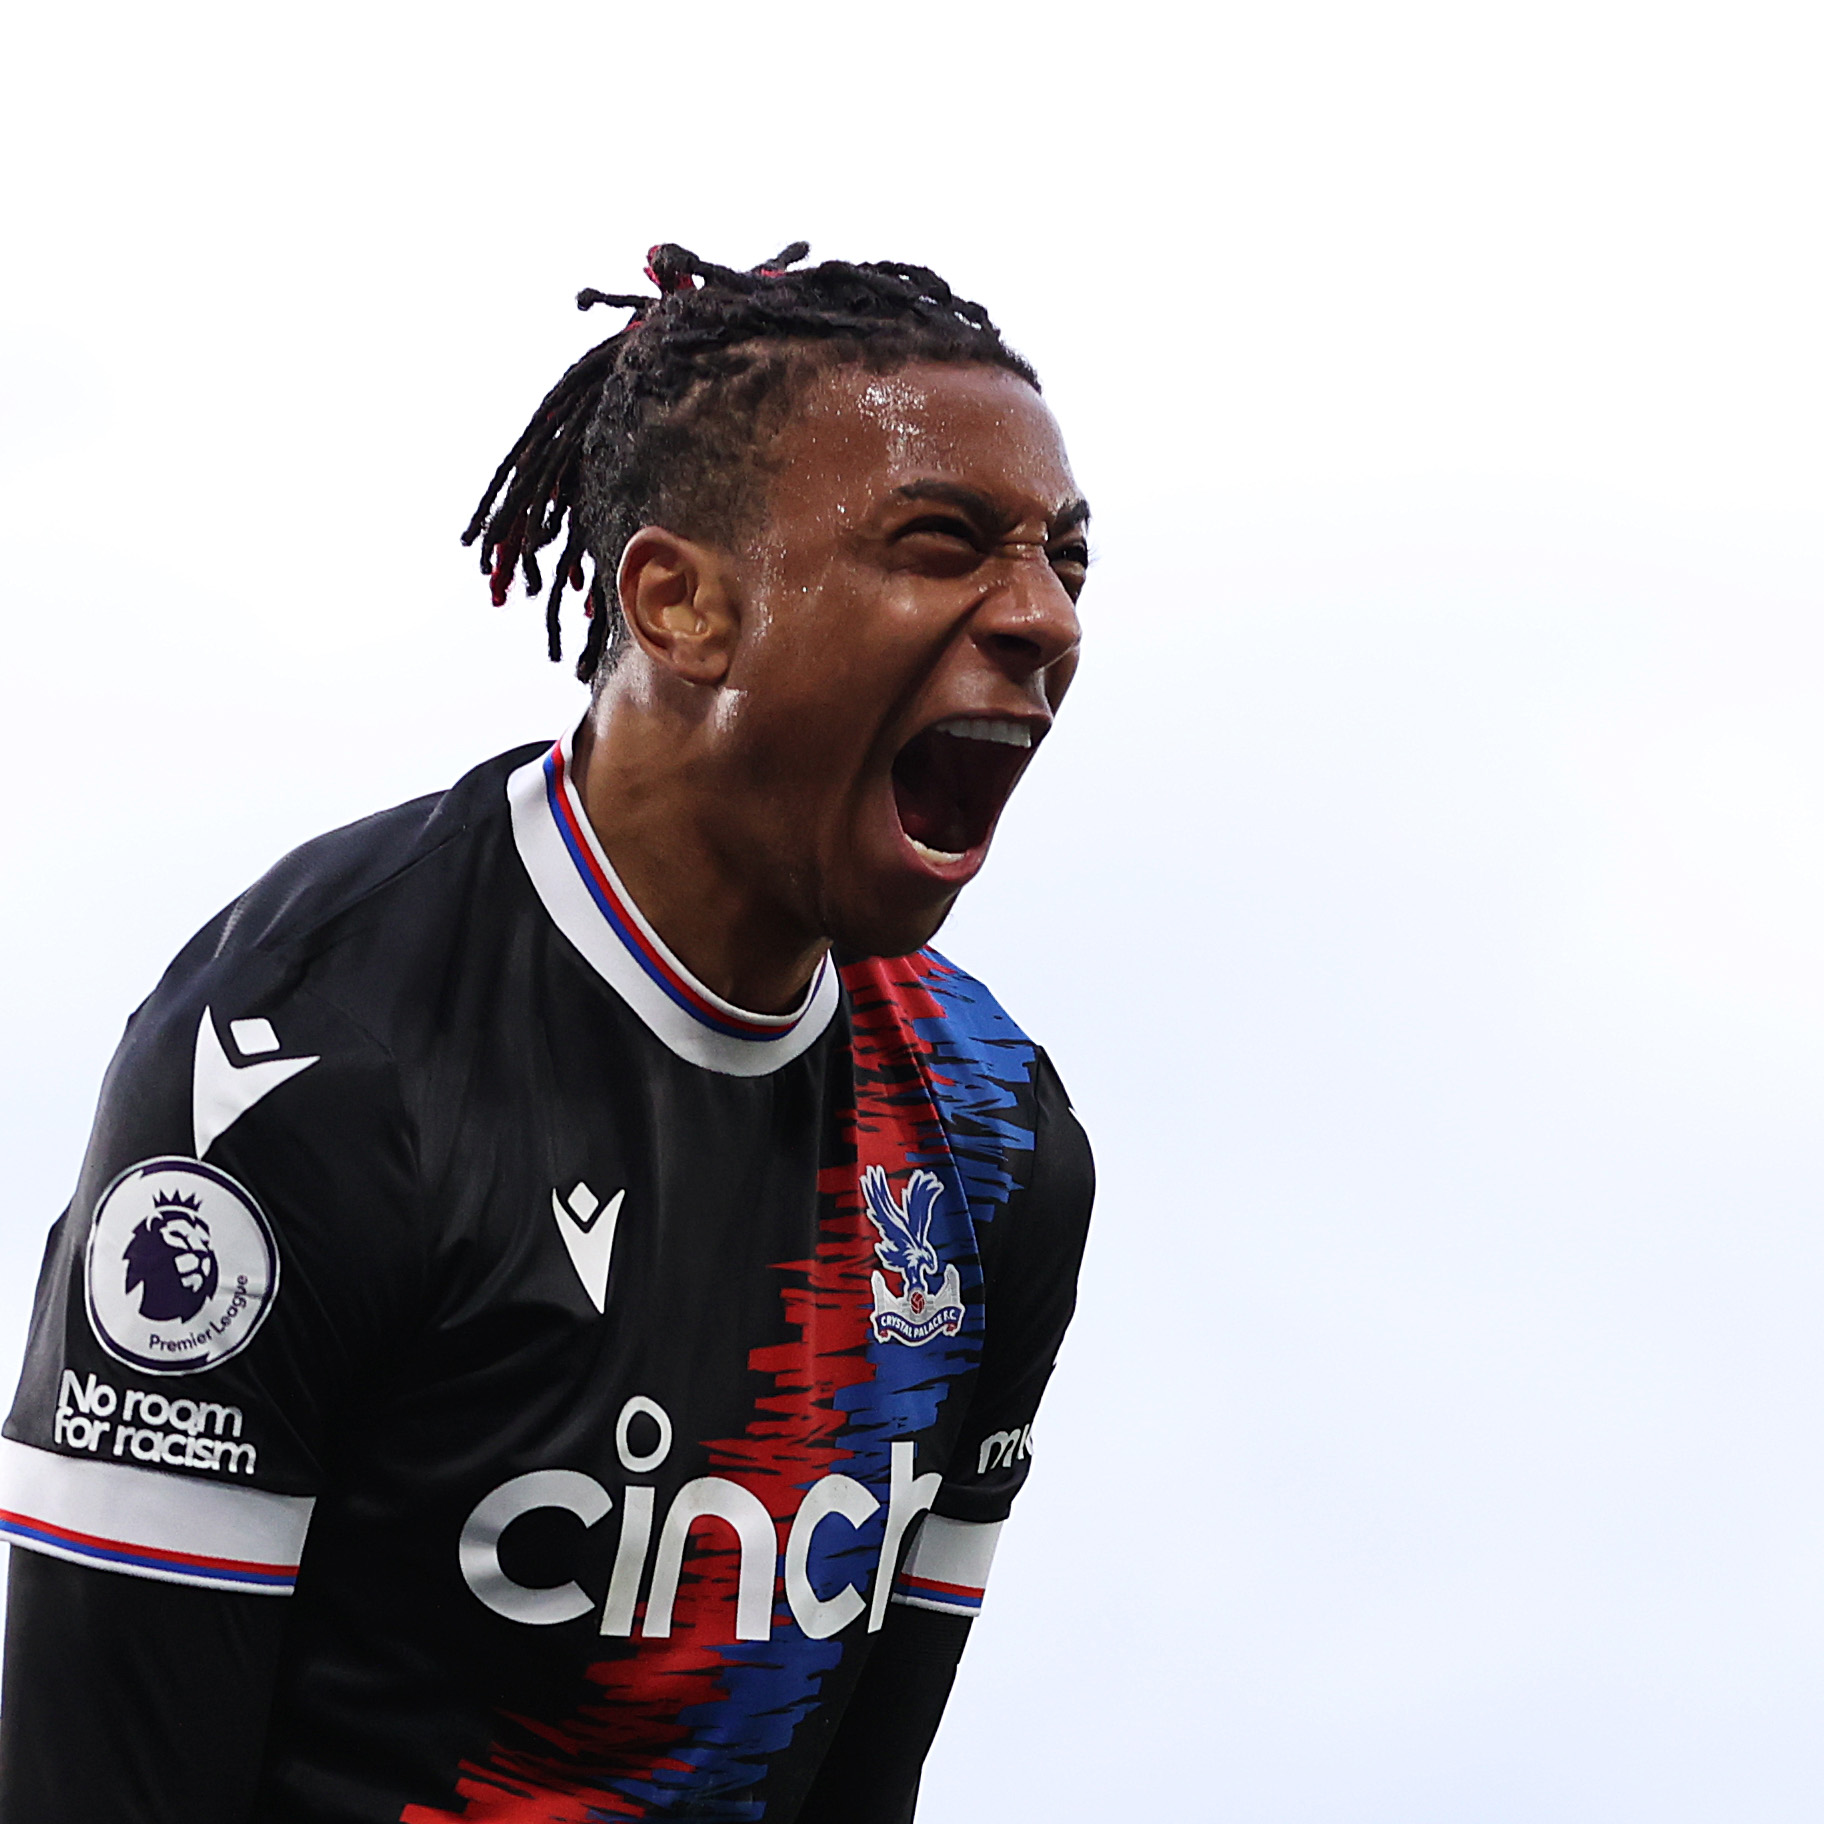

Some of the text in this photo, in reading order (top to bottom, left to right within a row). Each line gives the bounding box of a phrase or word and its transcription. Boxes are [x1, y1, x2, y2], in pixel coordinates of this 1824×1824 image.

[149, 1274, 248, 1352] Premier League
[881, 1314, 913, 1338] CRYSTAL
[913, 1313, 943, 1338] PALACE
[58, 1369, 243, 1437] No room
[54, 1406, 257, 1475] for racism
